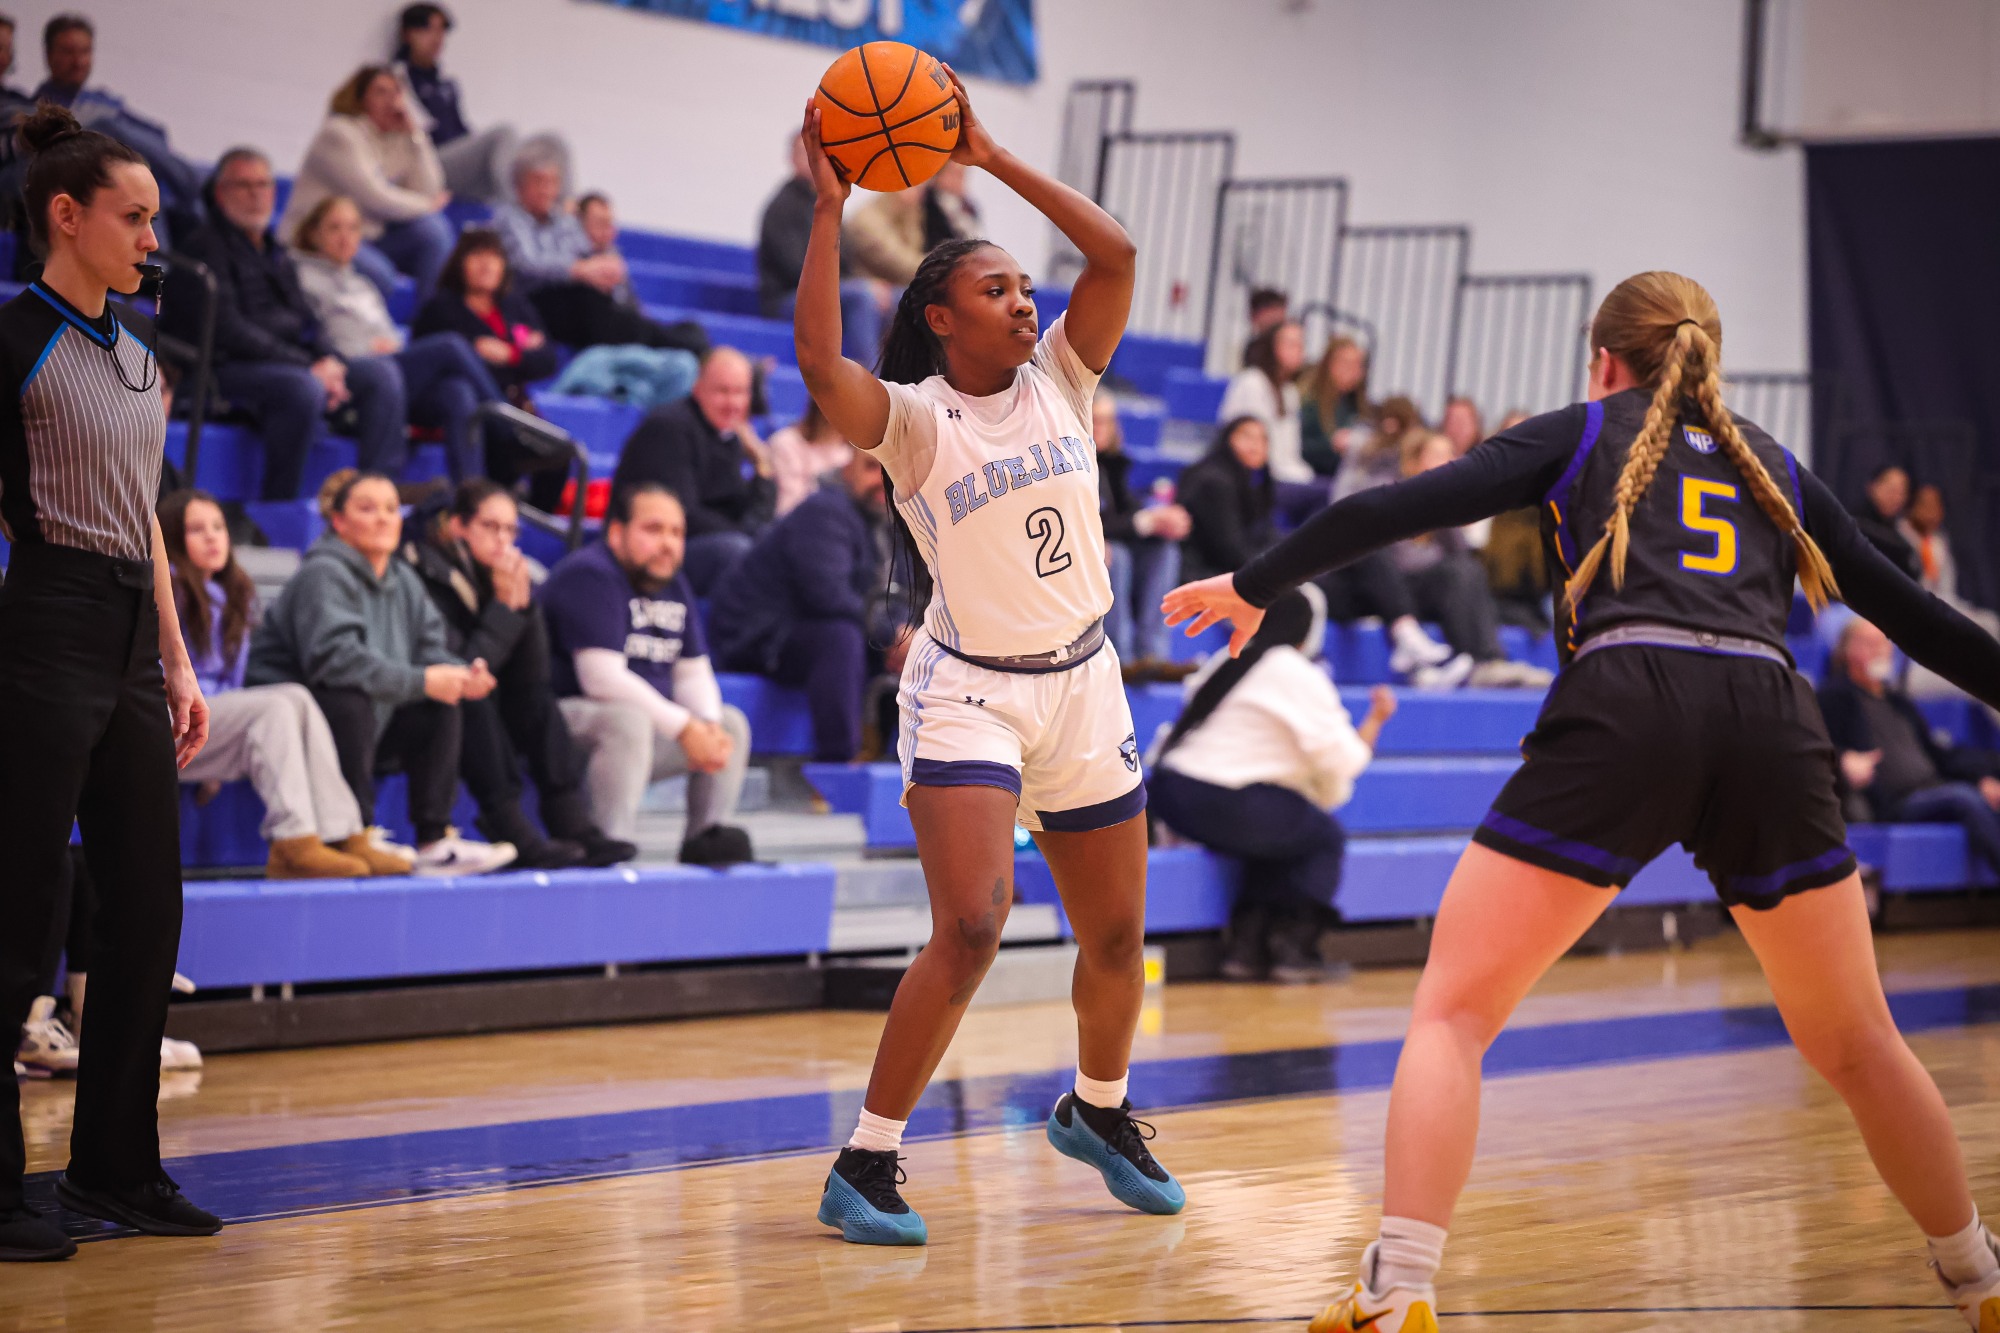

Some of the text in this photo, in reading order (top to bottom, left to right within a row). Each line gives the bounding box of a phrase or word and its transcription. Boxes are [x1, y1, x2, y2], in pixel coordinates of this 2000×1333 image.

[1688, 432, 1713, 450] NP
[1026, 507, 1072, 578] 2
[1679, 474, 1740, 577] 5
